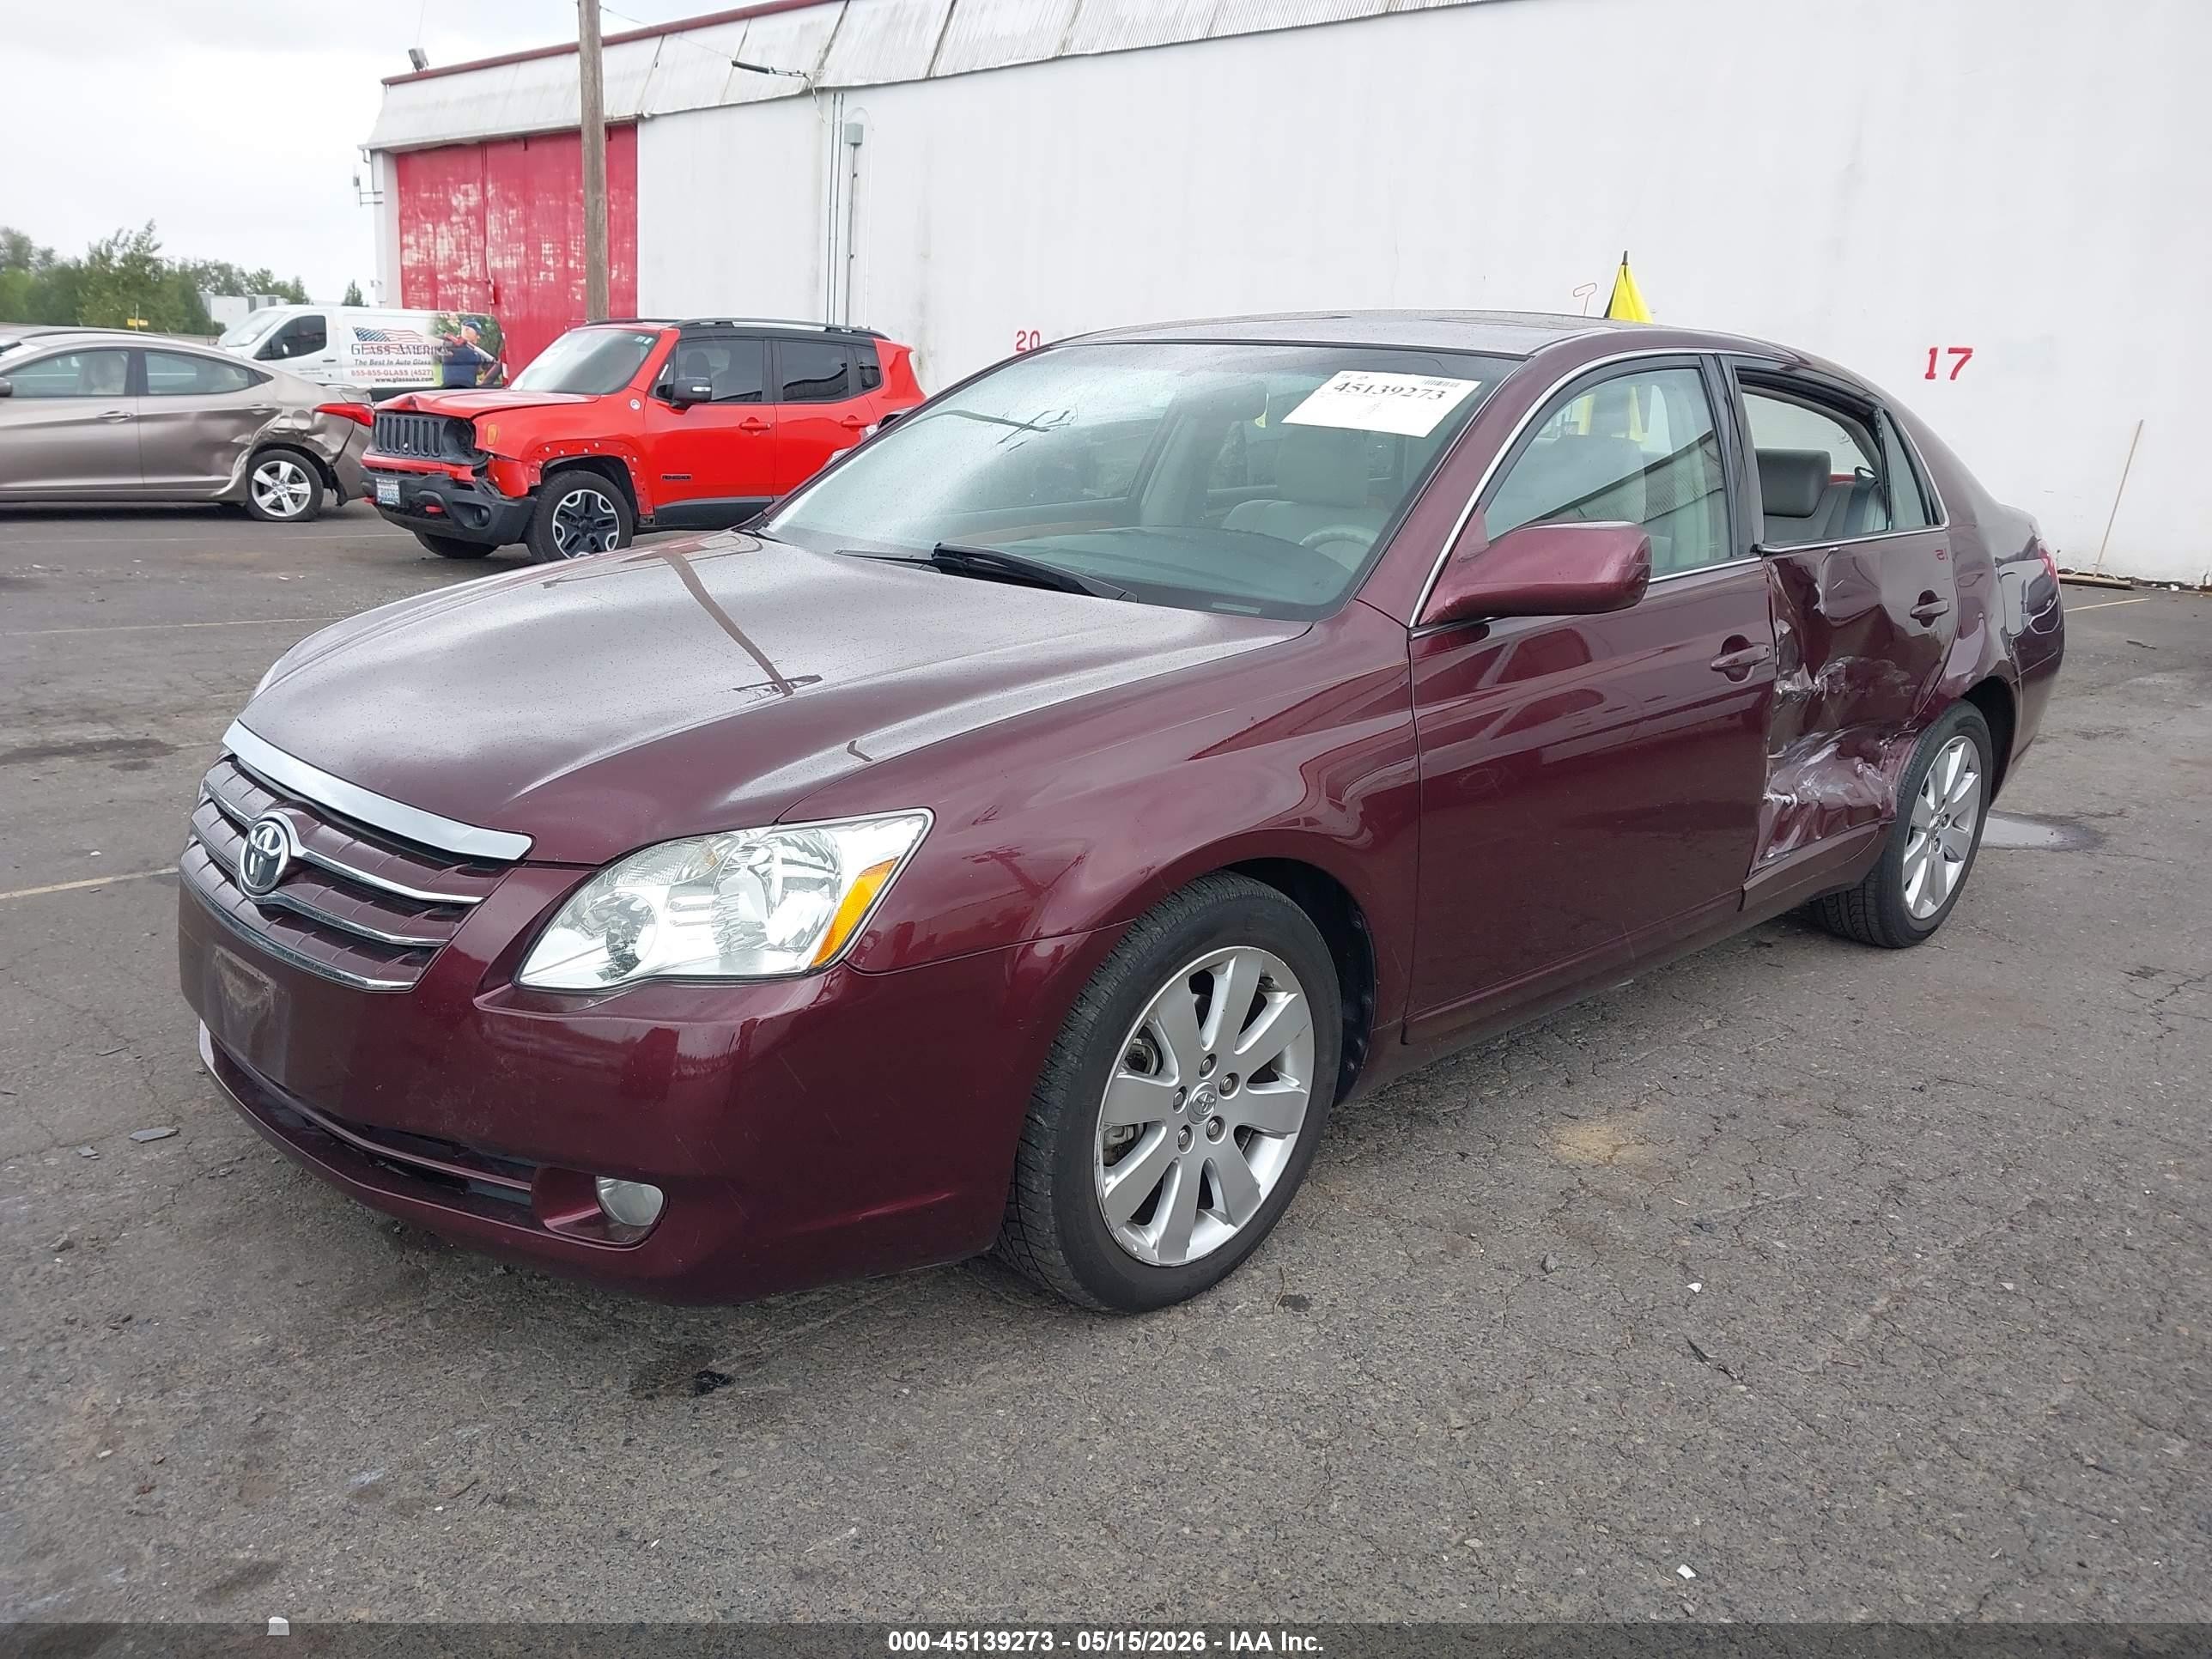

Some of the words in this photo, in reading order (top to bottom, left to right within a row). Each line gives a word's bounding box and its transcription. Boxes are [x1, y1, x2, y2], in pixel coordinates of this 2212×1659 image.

[350, 343, 391, 355] GLASS
[1016, 330, 1041, 351] 20
[1924, 347, 1973, 380] 17
[1334, 381, 1447, 400] 45139273
